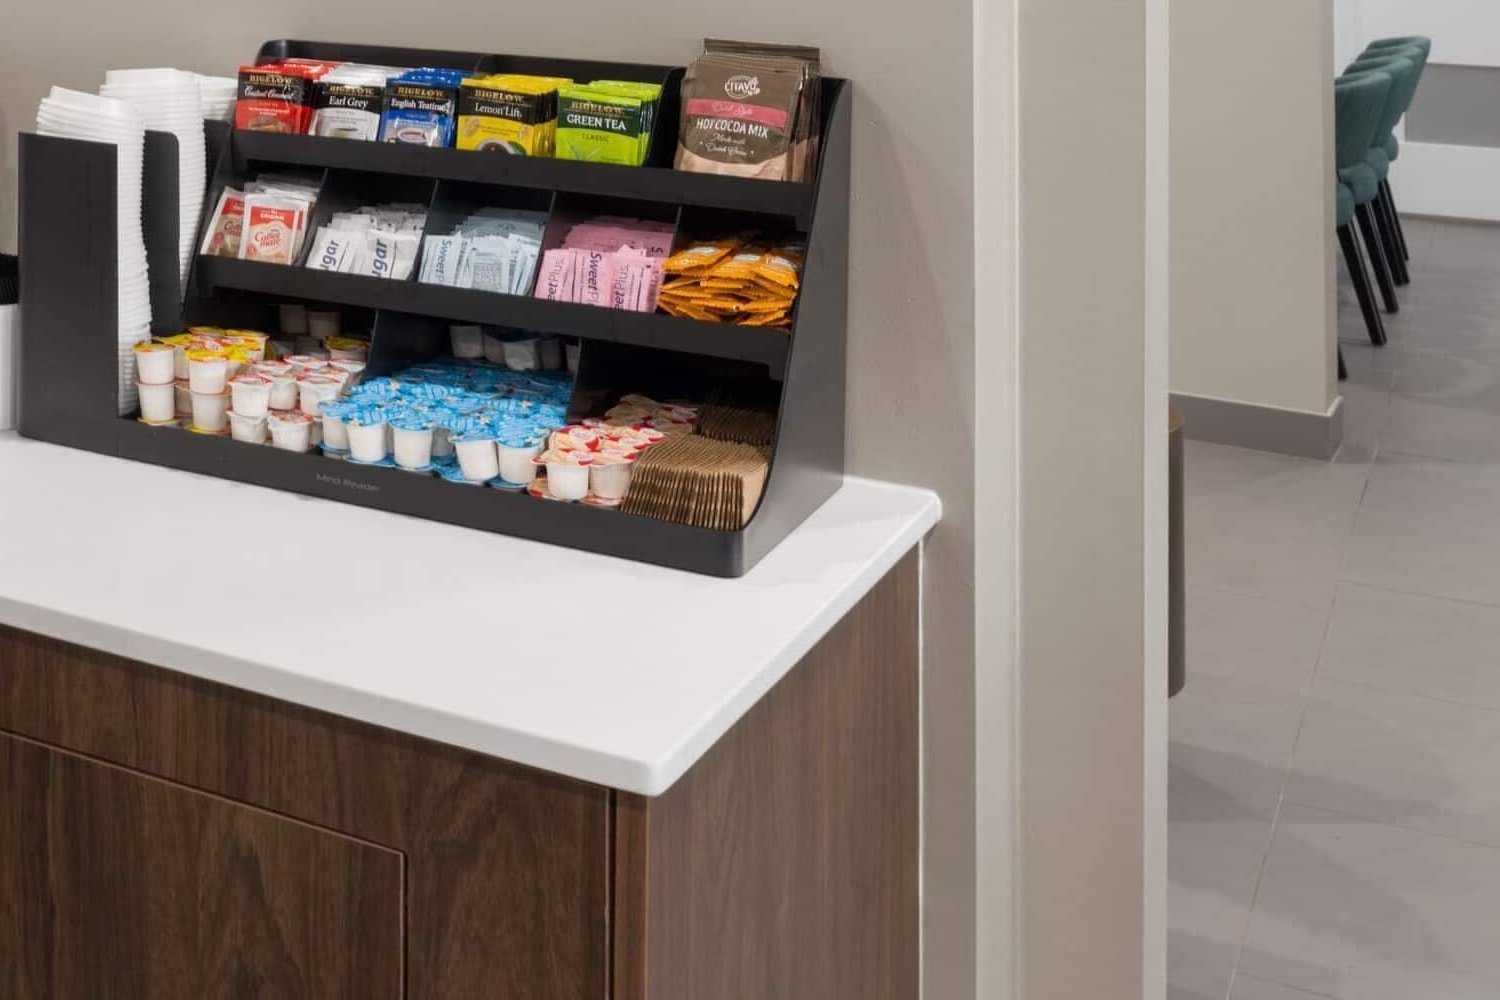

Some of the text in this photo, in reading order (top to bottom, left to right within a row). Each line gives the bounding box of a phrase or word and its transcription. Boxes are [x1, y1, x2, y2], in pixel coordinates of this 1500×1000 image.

[397, 87, 444, 98] BIGELOW
[474, 90, 524, 103] BIGELOW
[329, 96, 369, 110] Earl Grey
[391, 98, 417, 110] English
[475, 103, 502, 115] Lemon
[566, 114, 627, 131] GREEN TEA
[696, 118, 714, 130] HOT
[715, 119, 746, 136] COCOA
[747, 123, 769, 140] MIX
